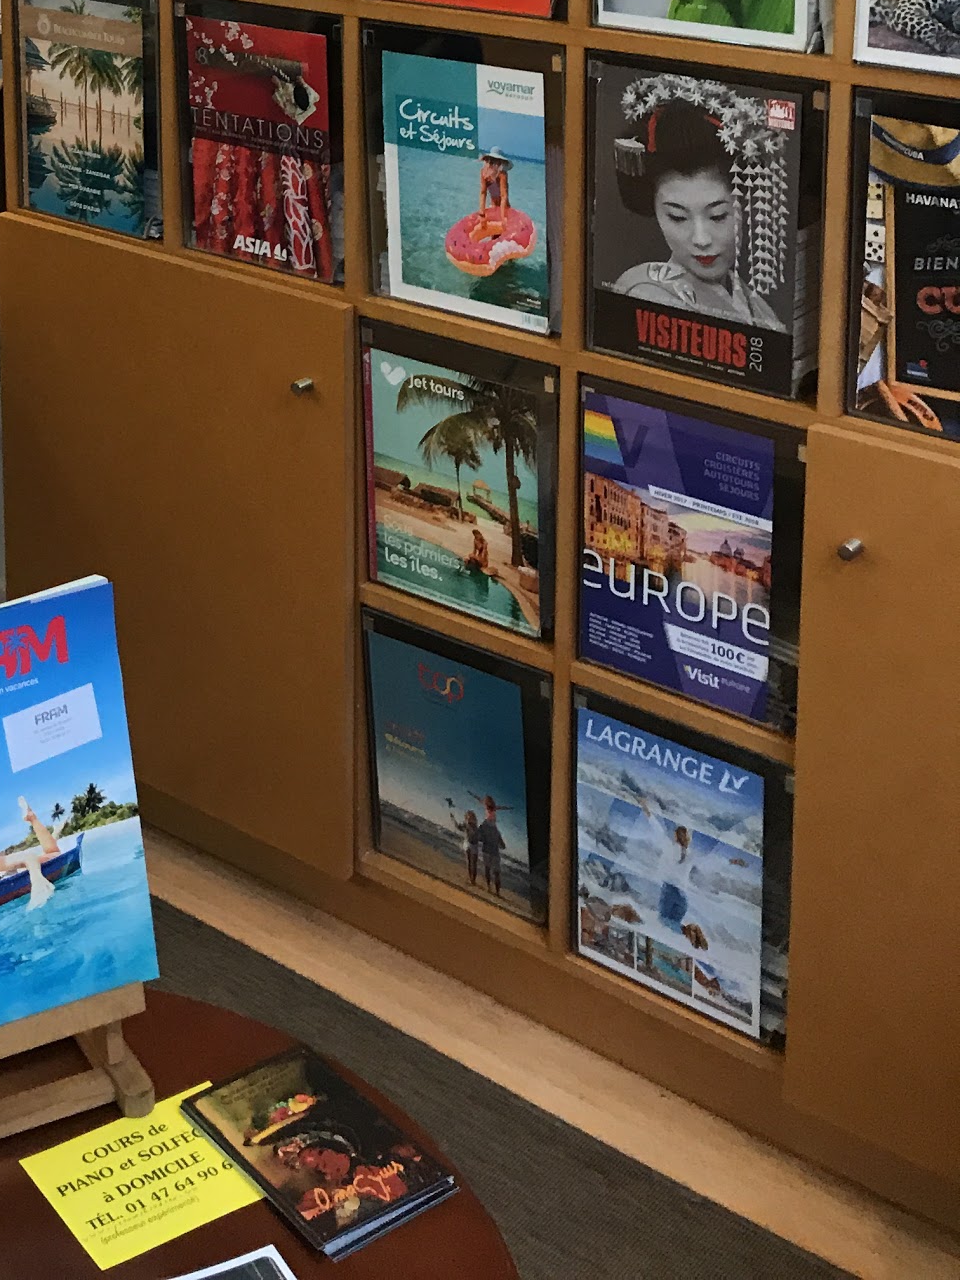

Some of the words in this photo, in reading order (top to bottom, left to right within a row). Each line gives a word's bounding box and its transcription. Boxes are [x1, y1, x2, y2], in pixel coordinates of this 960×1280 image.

[487, 79, 536, 96] voyamar
[191, 106, 324, 148] TENTATIONS
[399, 98, 475, 131] Circuits
[399, 122, 417, 140] et
[419, 125, 475, 151] Séjours
[233, 234, 271, 260] ASIA
[914, 257, 960, 271] BIEN
[636, 309, 747, 369] VISITEURS
[749, 336, 764, 372] 2018
[430, 381, 464, 401] tours
[716, 451, 760, 471] CIRCUITS
[703, 468, 760, 491] AUTOTOURS
[692, 501, 728, 517] PRINTEMPS
[384, 531, 401, 549] les
[385, 546, 407, 568] les
[5, 677, 39, 693] vacances
[685, 665, 720, 689] Visit
[34, 704, 69, 726] FRAM
[585, 718, 714, 786] LAGRANGE
[81, 1131, 145, 1164] COURS
[148, 1122, 169, 1138] de
[56, 1166, 114, 1197] PIANO
[119, 1157, 137, 1172] et
[102, 1190, 115, 1203] à
[117, 1151, 205, 1198] DOMICILE
[86, 1212, 124, 1230] TÉL.
[125, 1199, 145, 1213] 01
[151, 1187, 169, 1202] 47
[174, 1177, 194, 1191] 64
[197, 1166, 219, 1182] 90
[222, 1160, 234, 1172] 6
